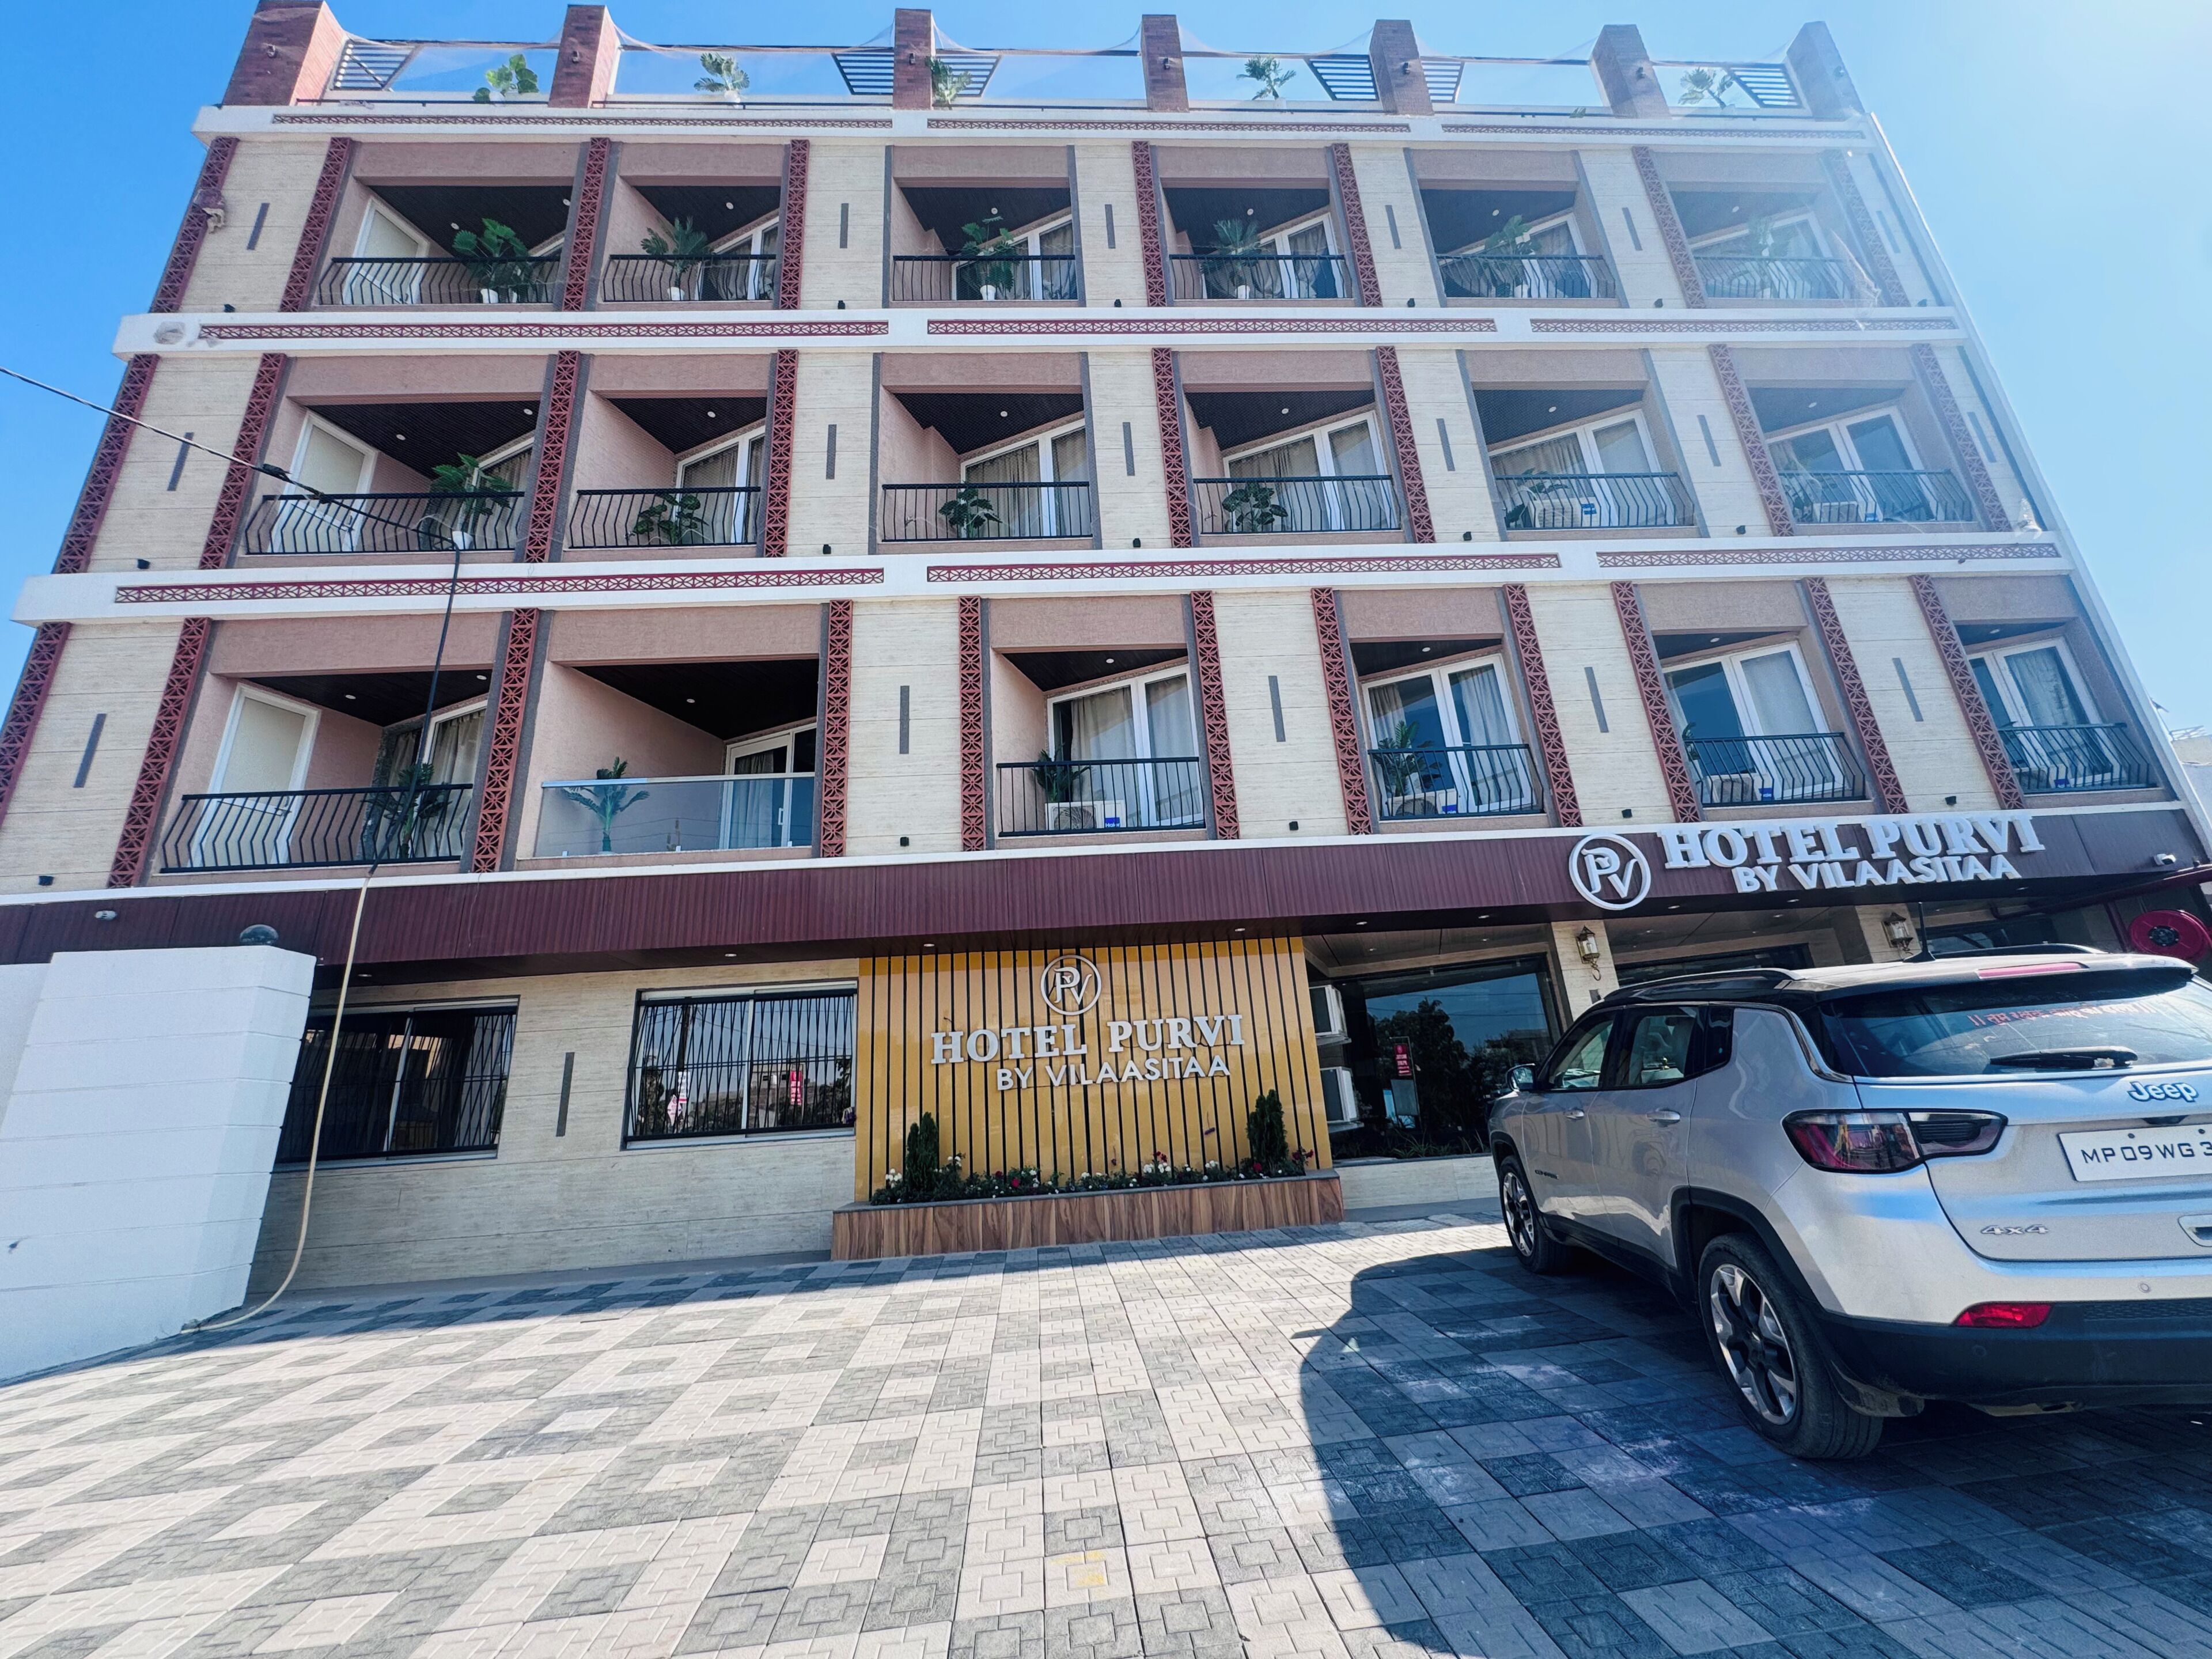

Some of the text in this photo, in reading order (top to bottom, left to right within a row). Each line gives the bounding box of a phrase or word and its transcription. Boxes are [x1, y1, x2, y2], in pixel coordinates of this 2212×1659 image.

[1657, 815, 2046, 869] HOTEL PURVI
[1731, 855, 2021, 893] BY VILAASITAA
[931, 1014, 1245, 1065] HOTEL PURVI
[997, 1055, 1230, 1091] BY VILAASITAA
[2128, 1081, 2199, 1103] Jeep
[1981, 1224, 2048, 1235] 4x4
